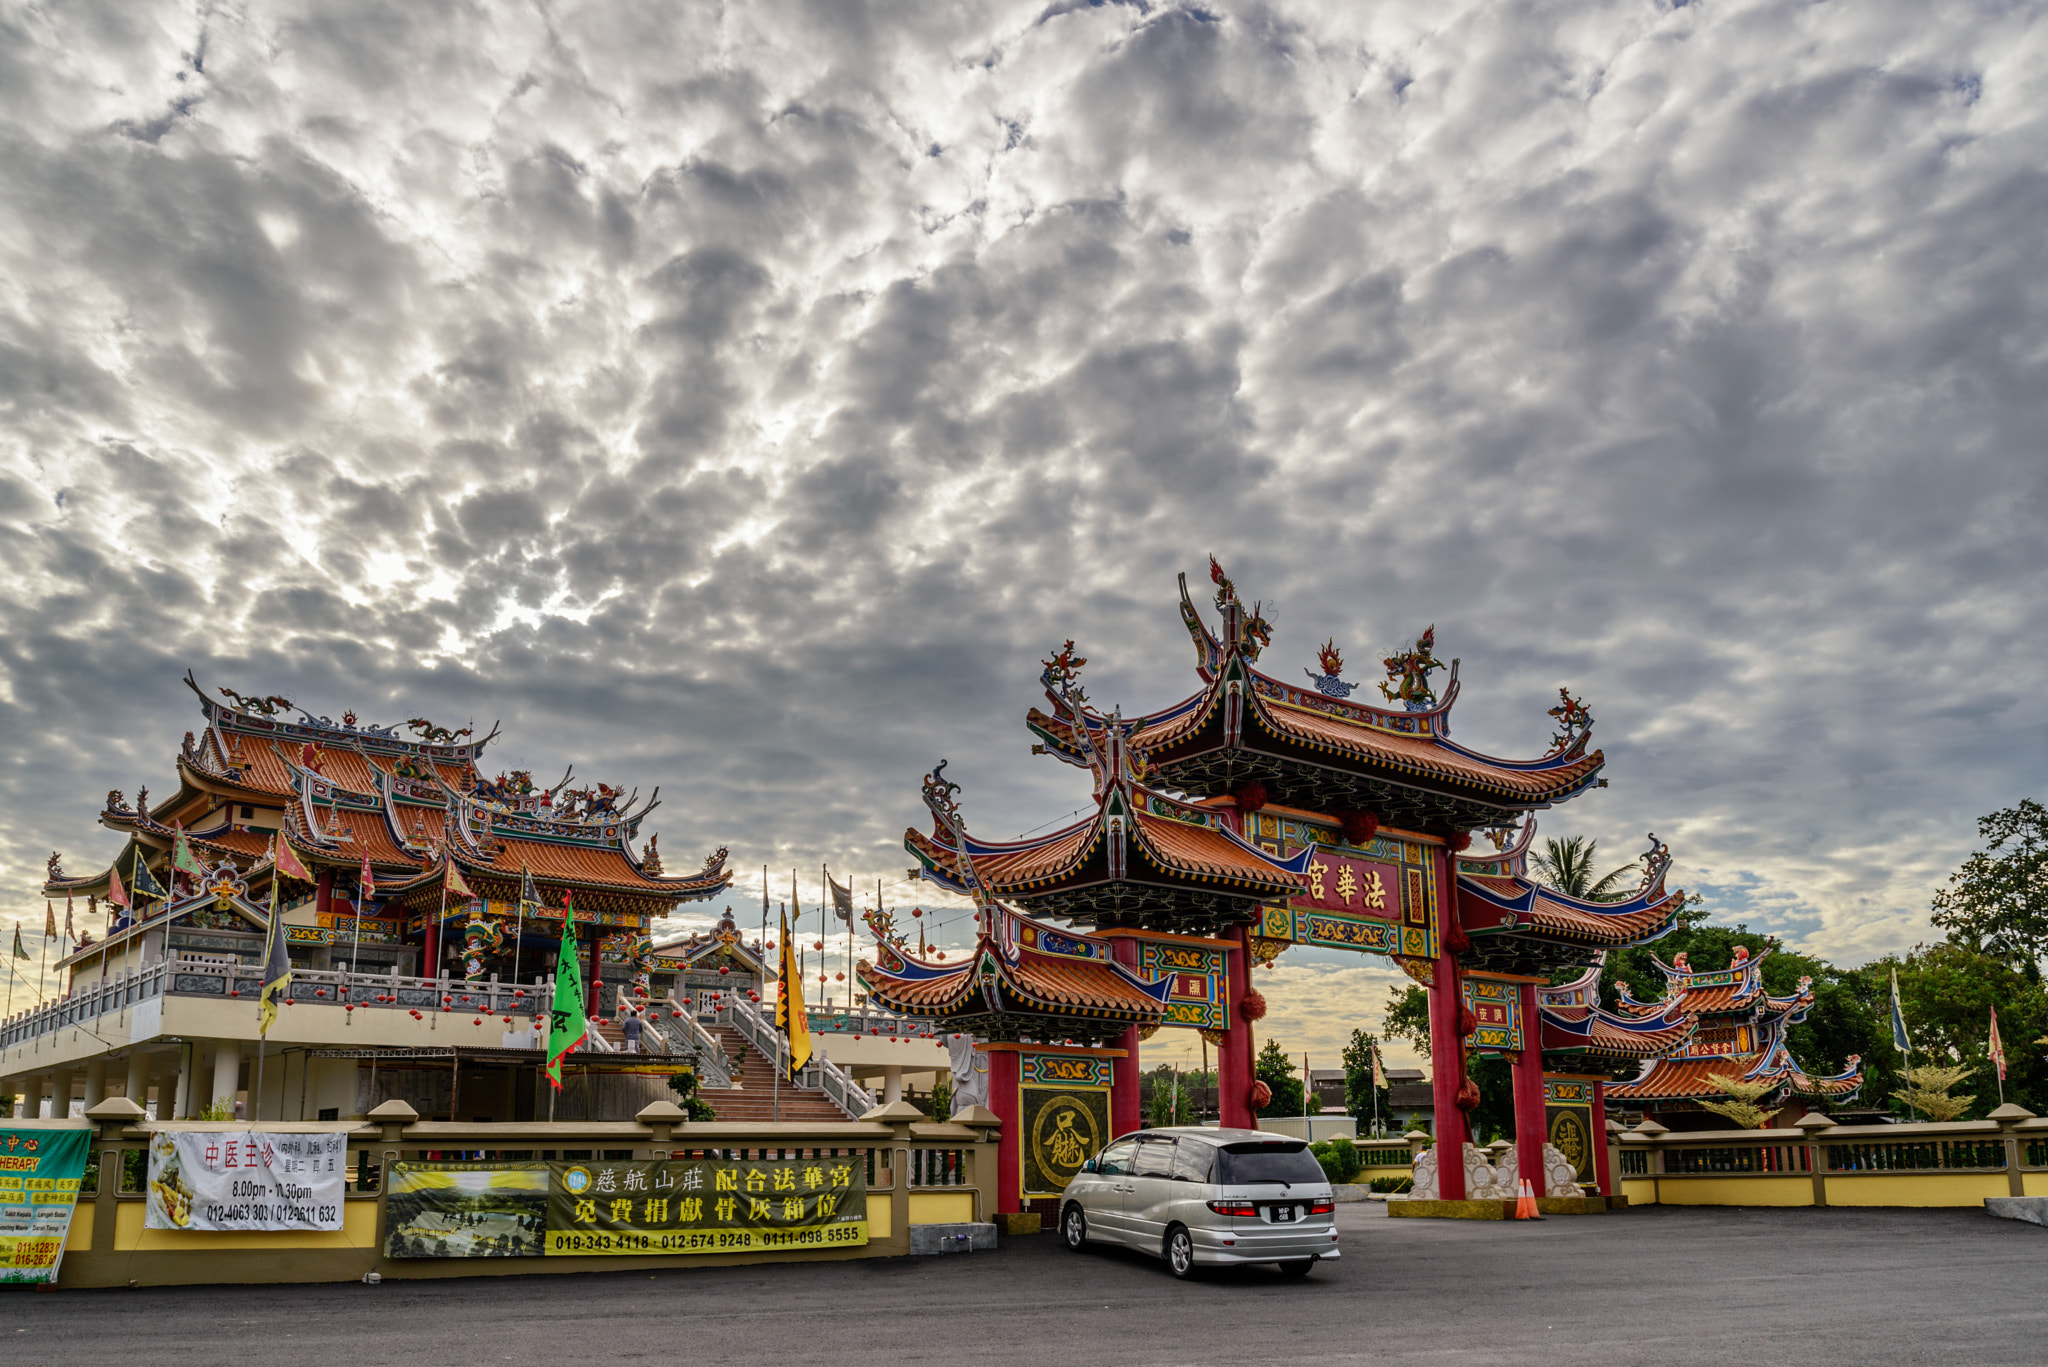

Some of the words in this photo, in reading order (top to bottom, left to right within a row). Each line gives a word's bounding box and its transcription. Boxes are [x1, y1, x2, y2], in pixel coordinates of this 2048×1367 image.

[0, 1133, 39, 1153] 中心
[205, 1140, 274, 1170] 中医主诊
[596, 1167, 704, 1193] 慈航山莊
[715, 1164, 851, 1192] 配合法華宮
[232, 1180, 266, 1201] 8.00pm
[207, 1204, 250, 1222] 012-4063
[252, 1204, 269, 1221] 303
[319, 1205, 336, 1222] 632
[556, 1235, 611, 1250] 019-343
[615, 1235, 649, 1249] 4118
[661, 1234, 714, 1249] 012-674
[719, 1233, 751, 1247] 9248
[763, 1230, 822, 1246] 0111-098
[828, 1227, 859, 1242] 5555
